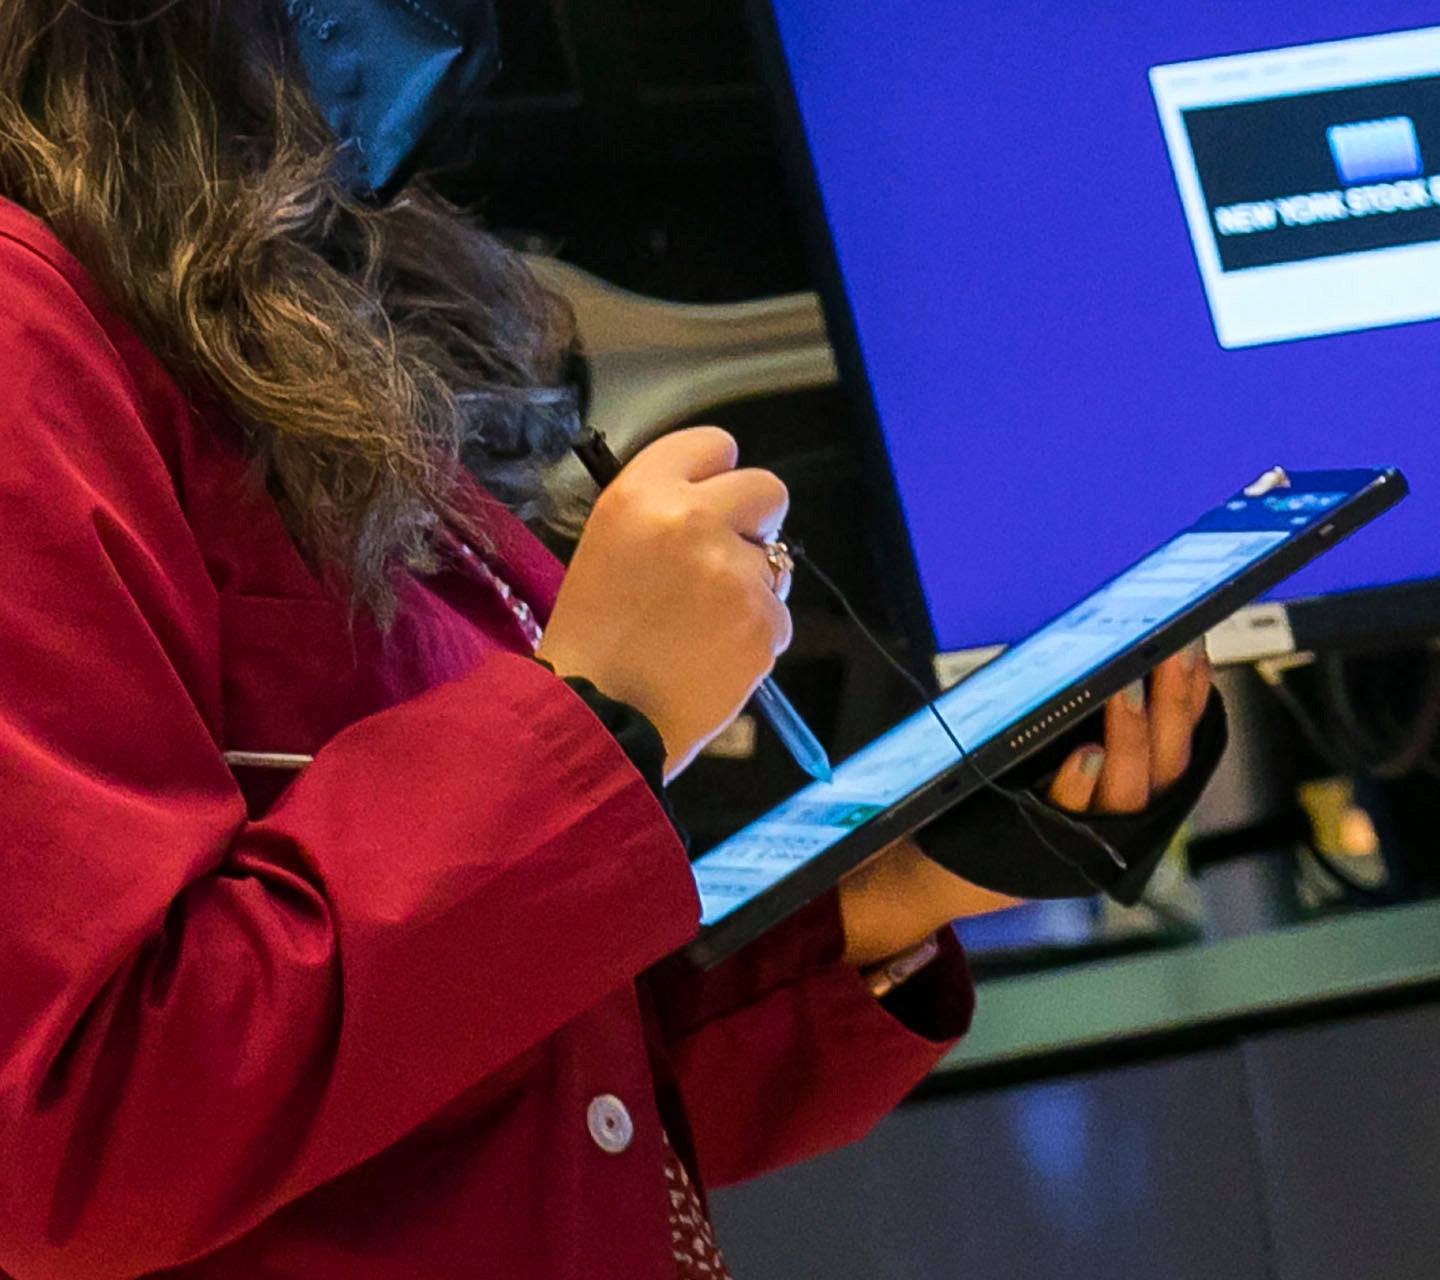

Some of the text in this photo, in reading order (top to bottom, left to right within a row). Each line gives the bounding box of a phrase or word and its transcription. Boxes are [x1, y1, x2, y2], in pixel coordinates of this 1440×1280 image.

[1214, 199, 1278, 236] NEW
[1273, 190, 1349, 226] YORK
[1346, 178, 1434, 217] STOCK
